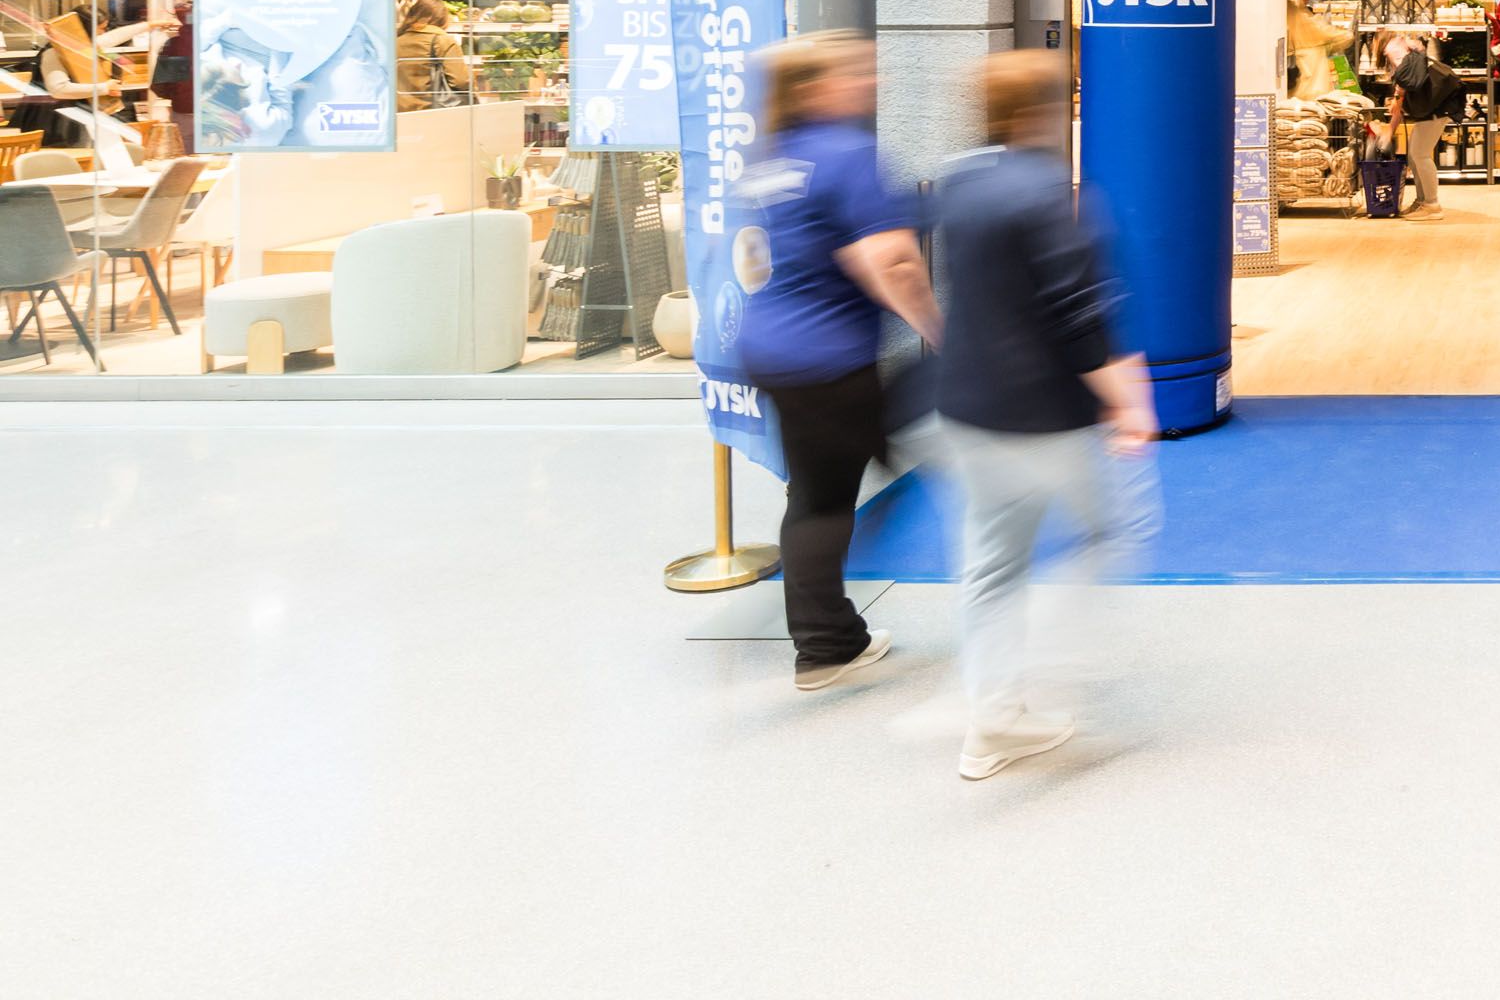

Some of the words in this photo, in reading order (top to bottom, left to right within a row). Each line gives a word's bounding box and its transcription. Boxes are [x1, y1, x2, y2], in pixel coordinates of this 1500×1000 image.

[623, 10, 667, 38] BIS
[721, 5, 756, 182] Große
[331, 109, 379, 124] JYSK
[705, 379, 762, 418] JYSK
